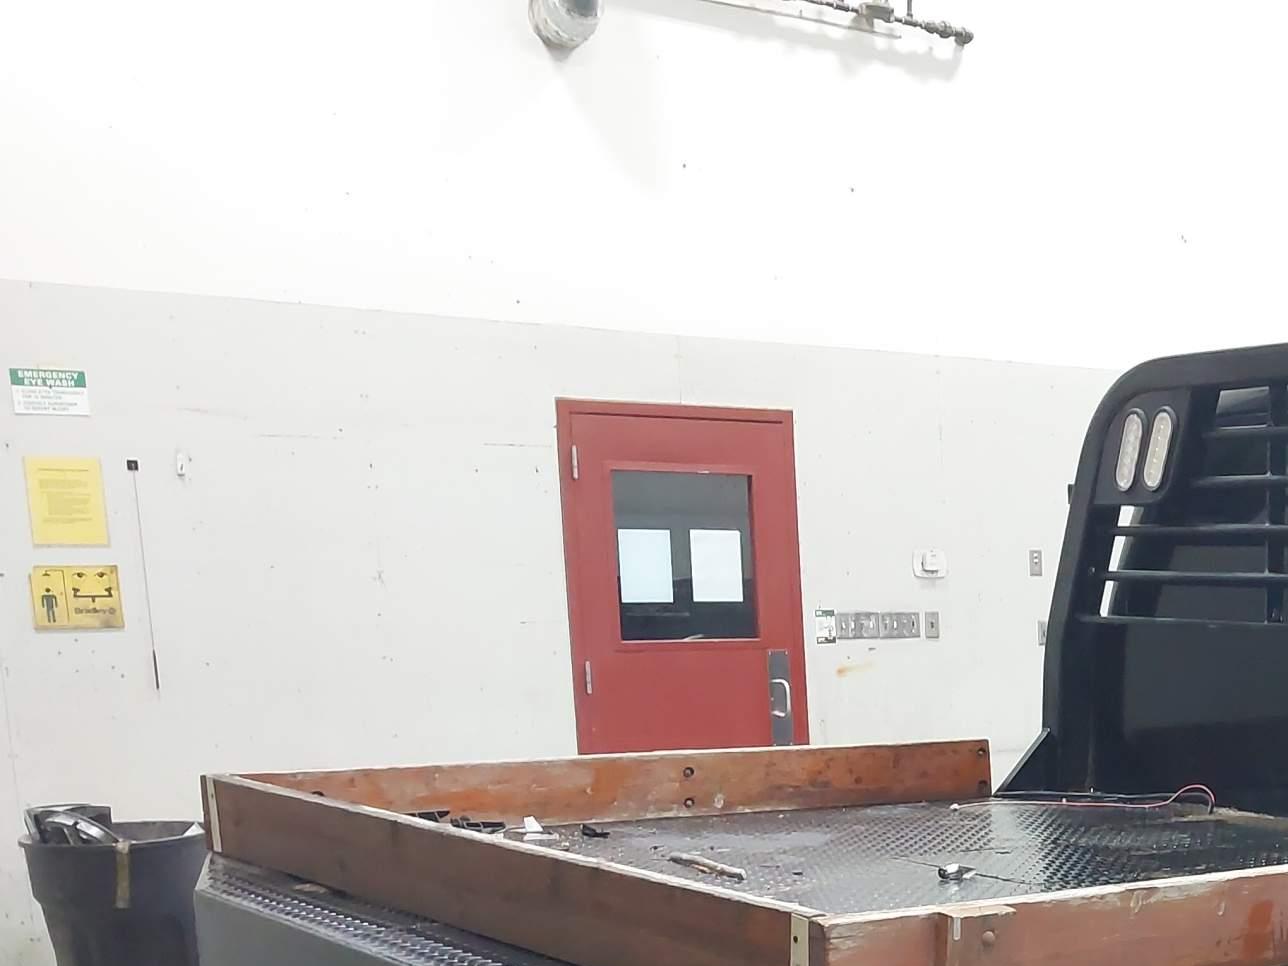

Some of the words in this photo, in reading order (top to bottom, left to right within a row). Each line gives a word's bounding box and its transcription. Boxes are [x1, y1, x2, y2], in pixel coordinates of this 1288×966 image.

[17, 370, 79, 380] EMERGENCY
[23, 378, 43, 386] EYE
[45, 379, 76, 387] WASH
